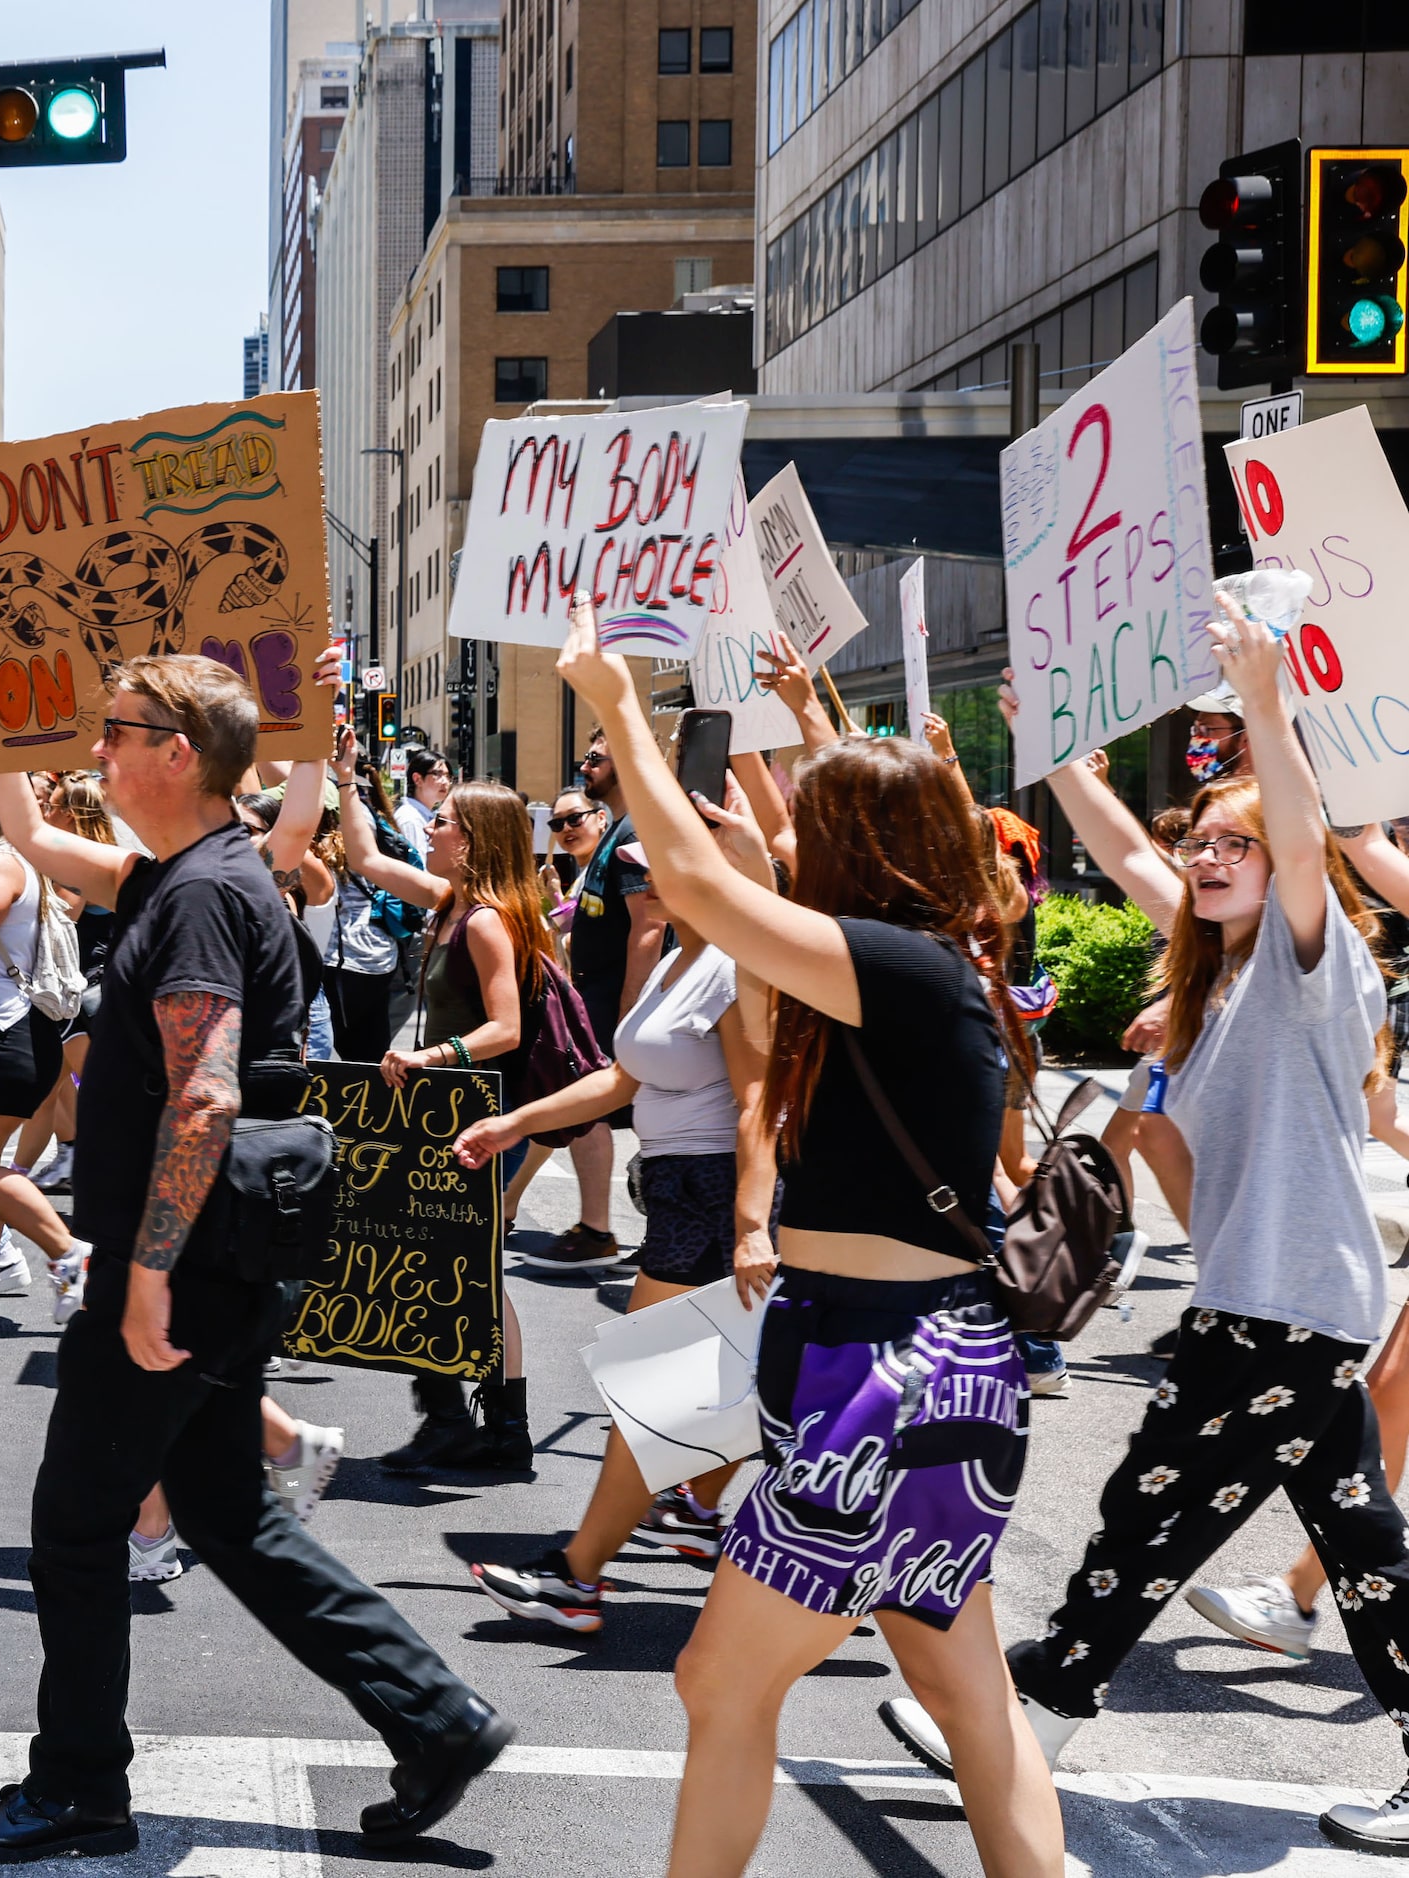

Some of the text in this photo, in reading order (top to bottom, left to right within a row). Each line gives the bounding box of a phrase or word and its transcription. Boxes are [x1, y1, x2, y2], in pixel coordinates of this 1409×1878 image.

[1253, 405, 1290, 439] ONE
[132, 431, 277, 507] TREAD
[595, 426, 706, 533] BODY
[1067, 403, 1123, 562] 2
[592, 532, 717, 611] CHOICE
[1025, 510, 1175, 671] STEPS
[1050, 608, 1179, 766] BACK
[296, 1074, 465, 1138] BANS
